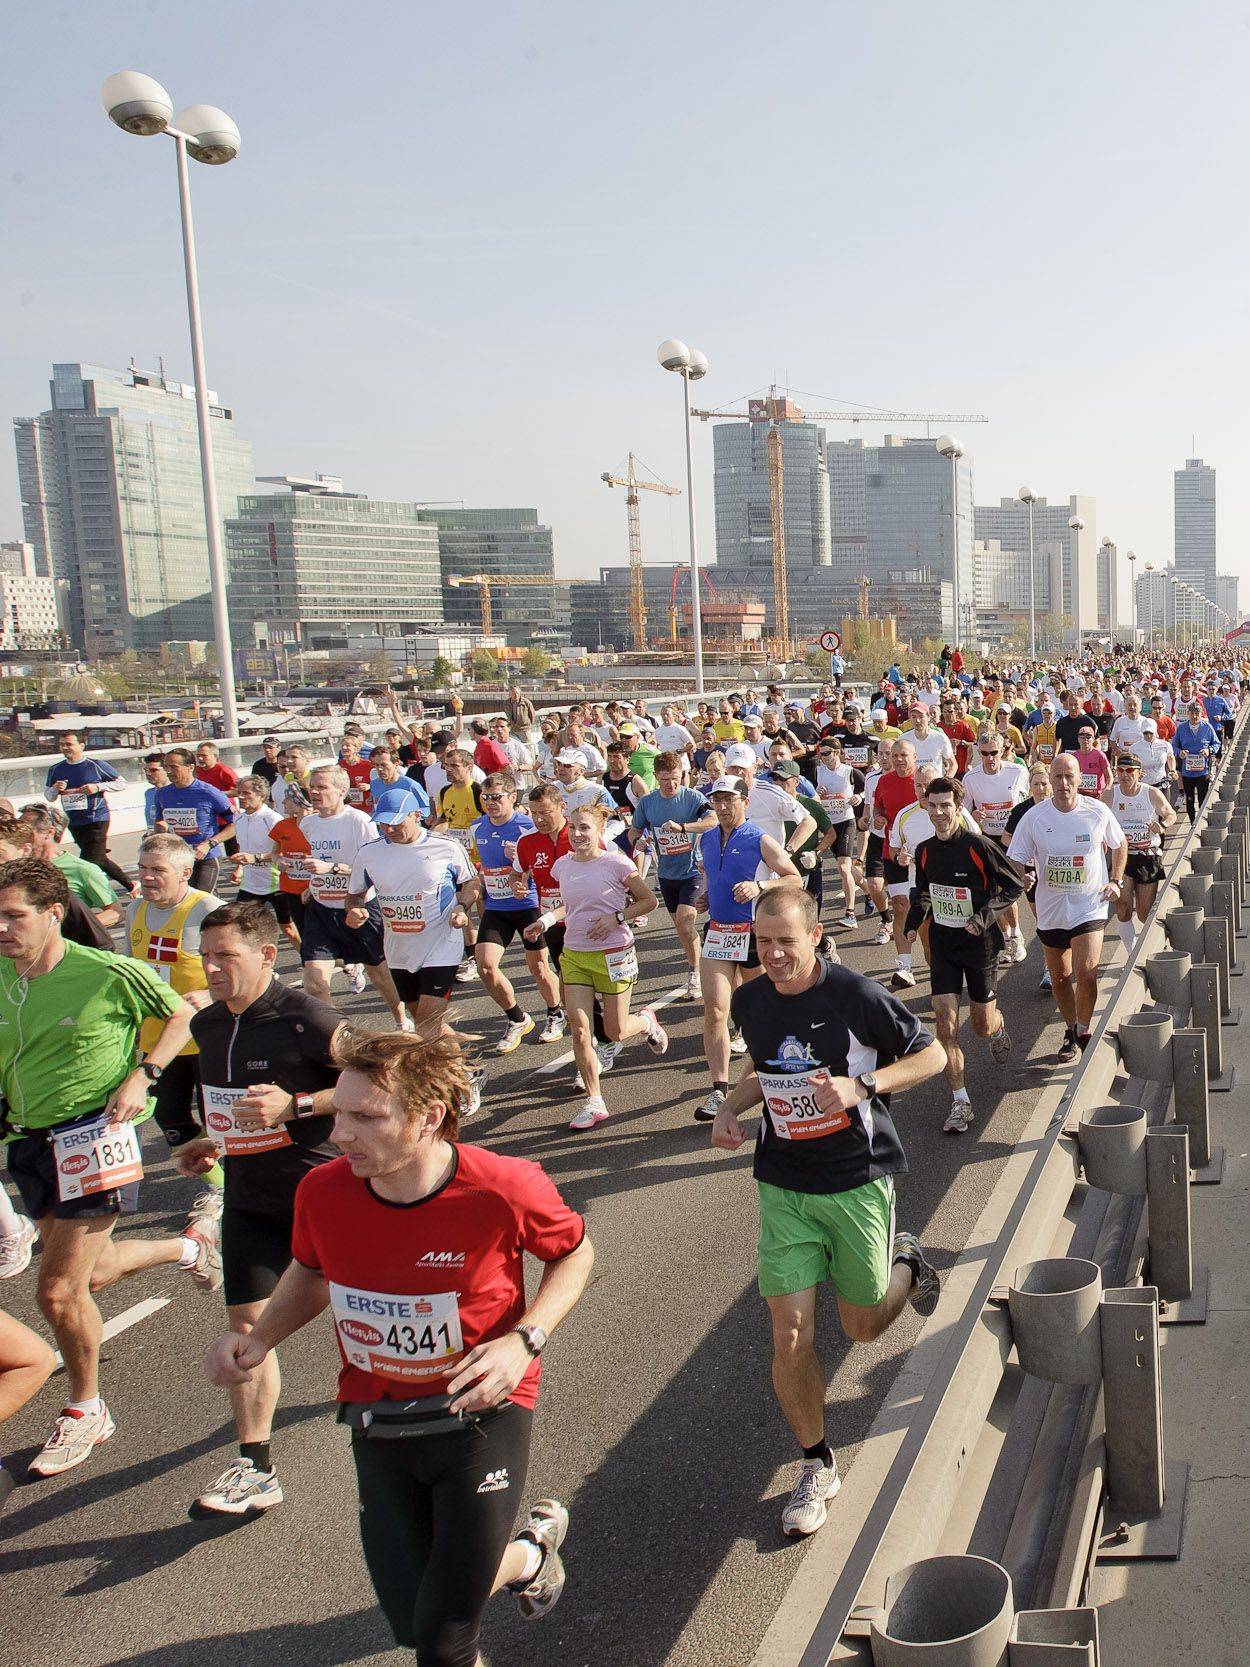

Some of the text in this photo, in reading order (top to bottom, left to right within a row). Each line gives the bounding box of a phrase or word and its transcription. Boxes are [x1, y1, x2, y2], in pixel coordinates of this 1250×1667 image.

[177, 817, 195, 827] 4020
[669, 833, 689, 845] 3149
[1133, 832, 1151, 841] 2048
[311, 840, 341, 850] SUOMI
[325, 876, 347, 889] 9492
[1048, 870, 1081, 883] 2178-A
[933, 891, 954, 899] SPECK
[396, 906, 422, 920] 9496
[938, 901, 964, 917] 789-A
[723, 935, 747, 949] 16241
[708, 950, 732, 959] ERSTE
[761, 1076, 808, 1089] SPARKASS
[769, 1098, 793, 1114] Hervis
[208, 1114, 231, 1128] Hervis
[63, 1127, 106, 1149] ERSTE
[91, 1138, 134, 1170] 1831
[62, 1155, 90, 1172] Hervis
[420, 1251, 466, 1262] AMA
[346, 1294, 411, 1318] ERSTE
[341, 1320, 382, 1343] Hervis
[387, 1322, 451, 1355] 4341
[373, 1360, 454, 1376] WIEN ENERGIE
